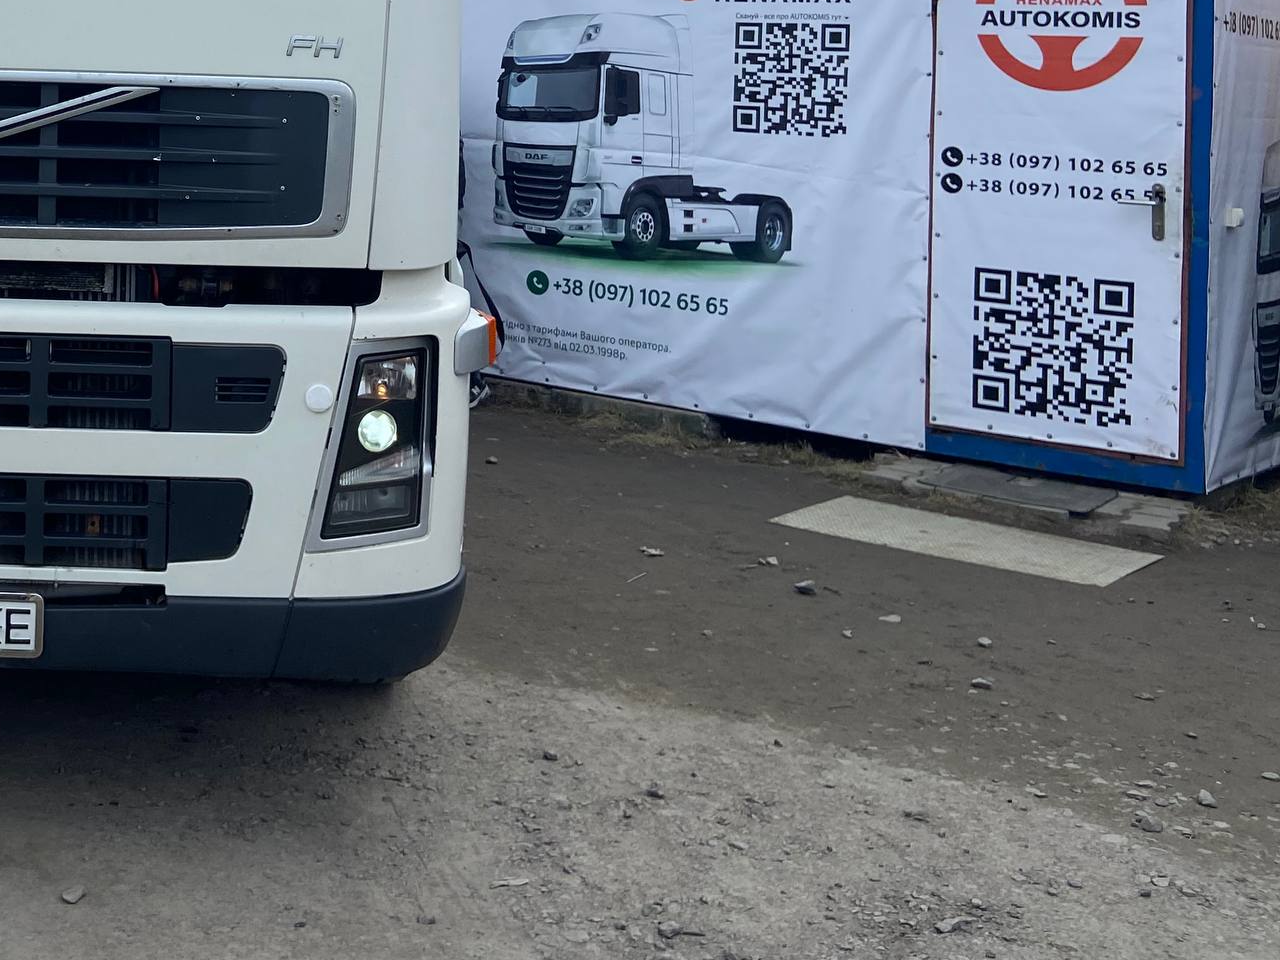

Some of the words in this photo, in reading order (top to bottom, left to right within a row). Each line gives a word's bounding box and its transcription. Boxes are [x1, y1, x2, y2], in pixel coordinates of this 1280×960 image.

[981, 10, 1141, 28] AUTOKOMIS
[1239, 11, 1258, 39] (097)
[1261, 18, 1274, 40] 102
[286, 35, 344, 59] FH
[524, 152, 549, 161] DAF
[967, 152, 1002, 166] +38
[1009, 153, 1060, 171] (097)
[1069, 158, 1104, 173] 102
[1111, 160, 1136, 174] 65
[1143, 162, 1168, 177] 65
[967, 179, 1002, 193] +38
[1009, 180, 1060, 198] (097)
[1069, 185, 1104, 200] 102
[1111, 188, 1135, 202] 65
[1143, 190, 1166, 202] 5
[553, 278, 583, 296] +38
[588, 279, 634, 308] (097)
[639, 288, 670, 308] 102
[677, 293, 700, 312] 65
[706, 297, 729, 316] 65
[503, 321, 525, 331] ідно
[533, 324, 578, 339] тарифами
[580, 330, 616, 345] Вашого
[618, 337, 672, 353] оператора.
[554, 341, 567, 351] від
[569, 342, 628, 361] 02.03.1998р.
